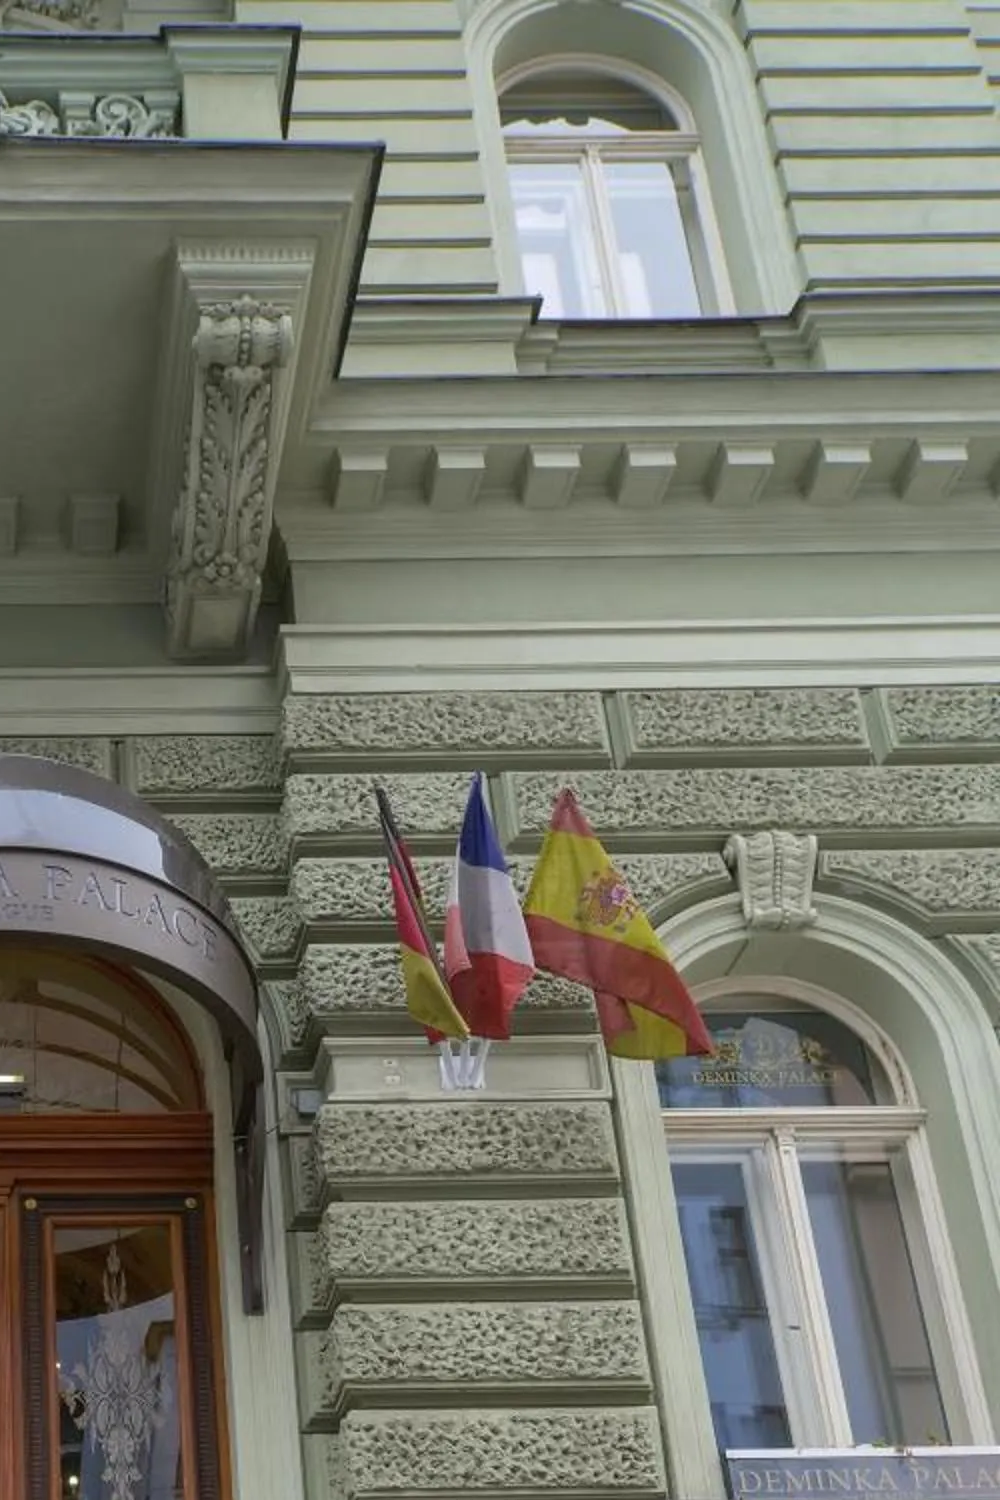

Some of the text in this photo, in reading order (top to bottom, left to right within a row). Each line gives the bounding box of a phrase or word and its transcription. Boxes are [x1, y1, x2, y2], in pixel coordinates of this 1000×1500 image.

[42, 863, 220, 962] PALACE
[691, 1070, 772, 1084] DEMINKA
[738, 1465, 1000, 1493] DEMINKA PALA
